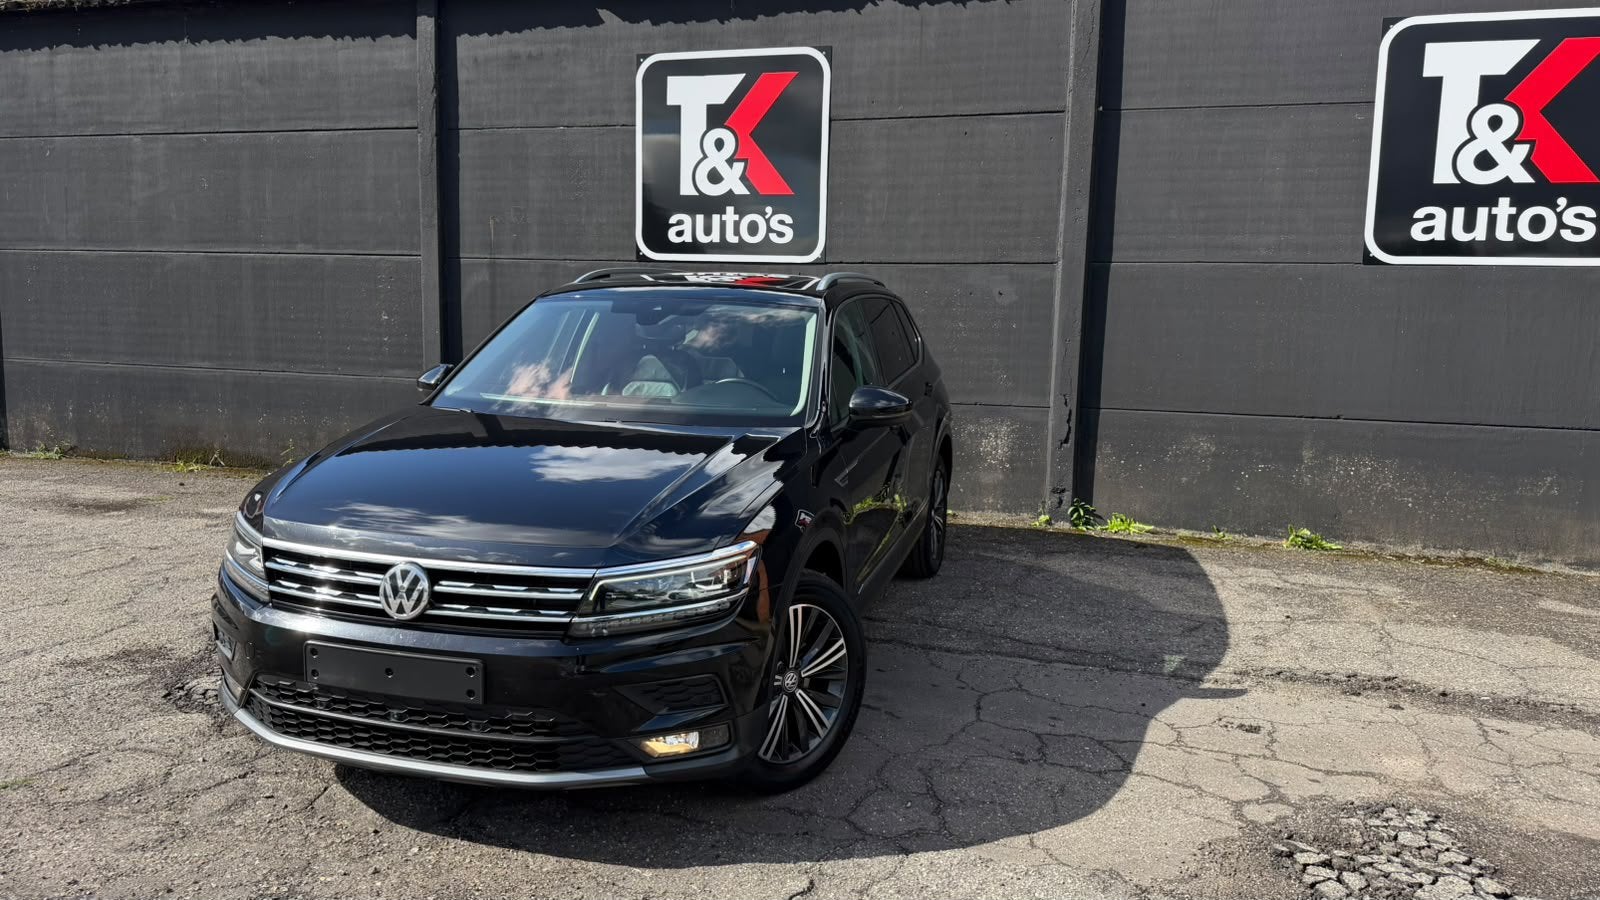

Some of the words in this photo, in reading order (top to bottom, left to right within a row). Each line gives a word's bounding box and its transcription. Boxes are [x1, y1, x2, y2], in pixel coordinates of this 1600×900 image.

[666, 71, 799, 196] T&K
[1422, 36, 1600, 185] T&K
[667, 205, 794, 244] auto's
[1410, 196, 1598, 243] auto's
